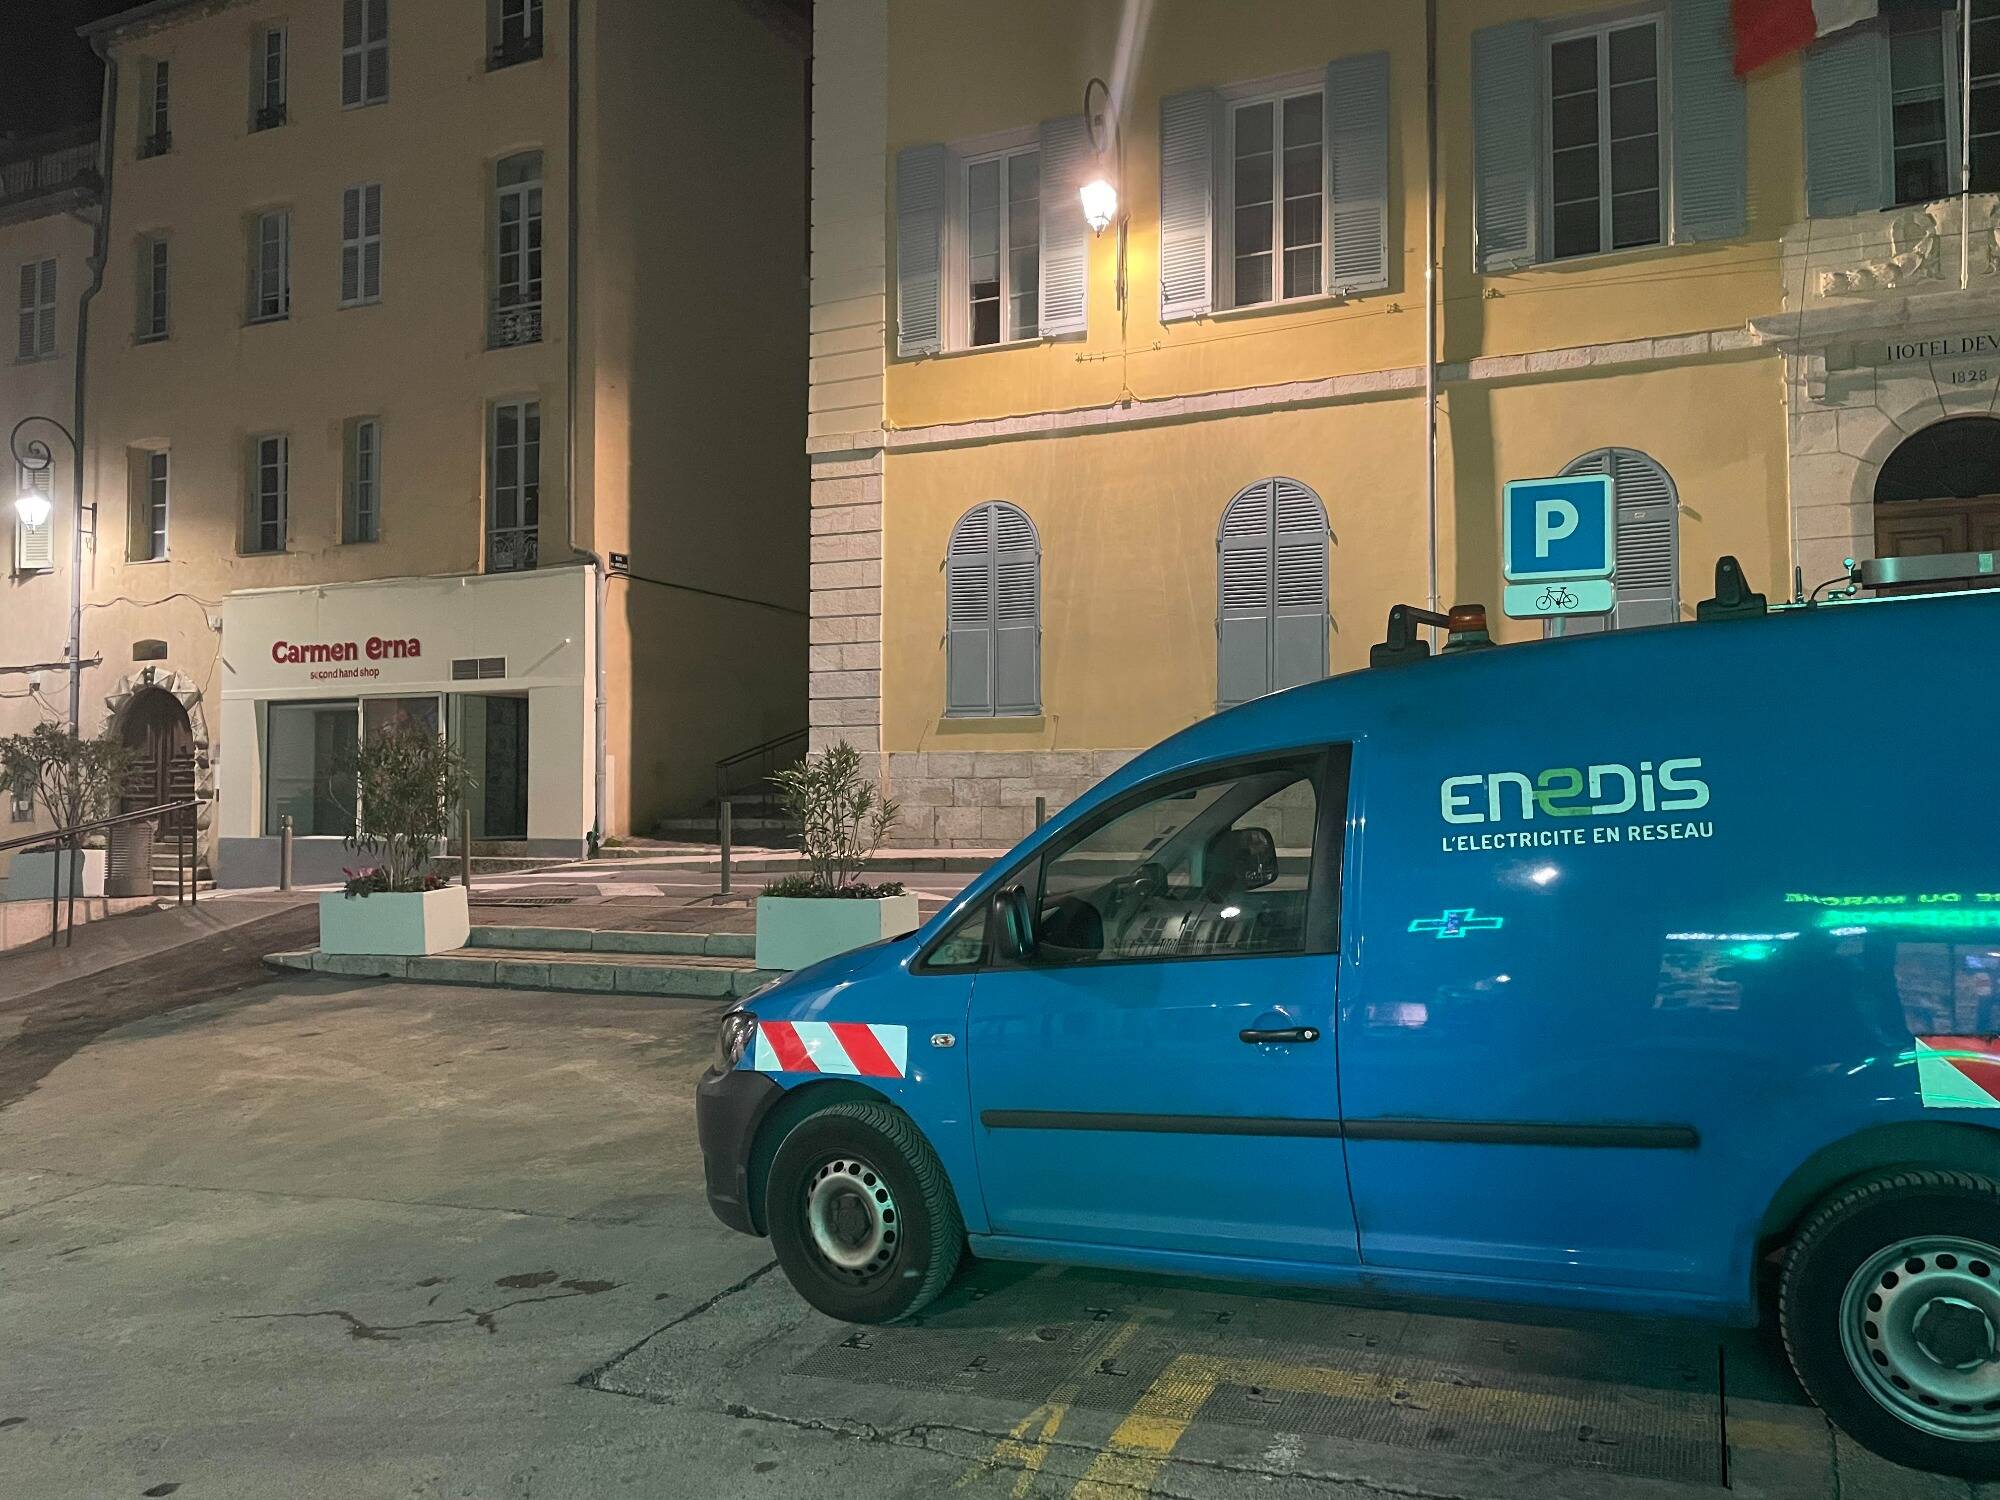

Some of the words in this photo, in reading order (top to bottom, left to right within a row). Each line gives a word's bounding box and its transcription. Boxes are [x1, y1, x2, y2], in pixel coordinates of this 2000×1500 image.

[1887, 341, 1955, 361] HOTEL
[1952, 370, 1988, 384] 1828
[1535, 499, 1579, 558] P
[272, 641, 358, 664] Carmen
[339, 668, 359, 678] hand
[360, 667, 380, 679] shop
[1593, 827, 1620, 844] EN
[1628, 821, 1713, 841] RESEAU
